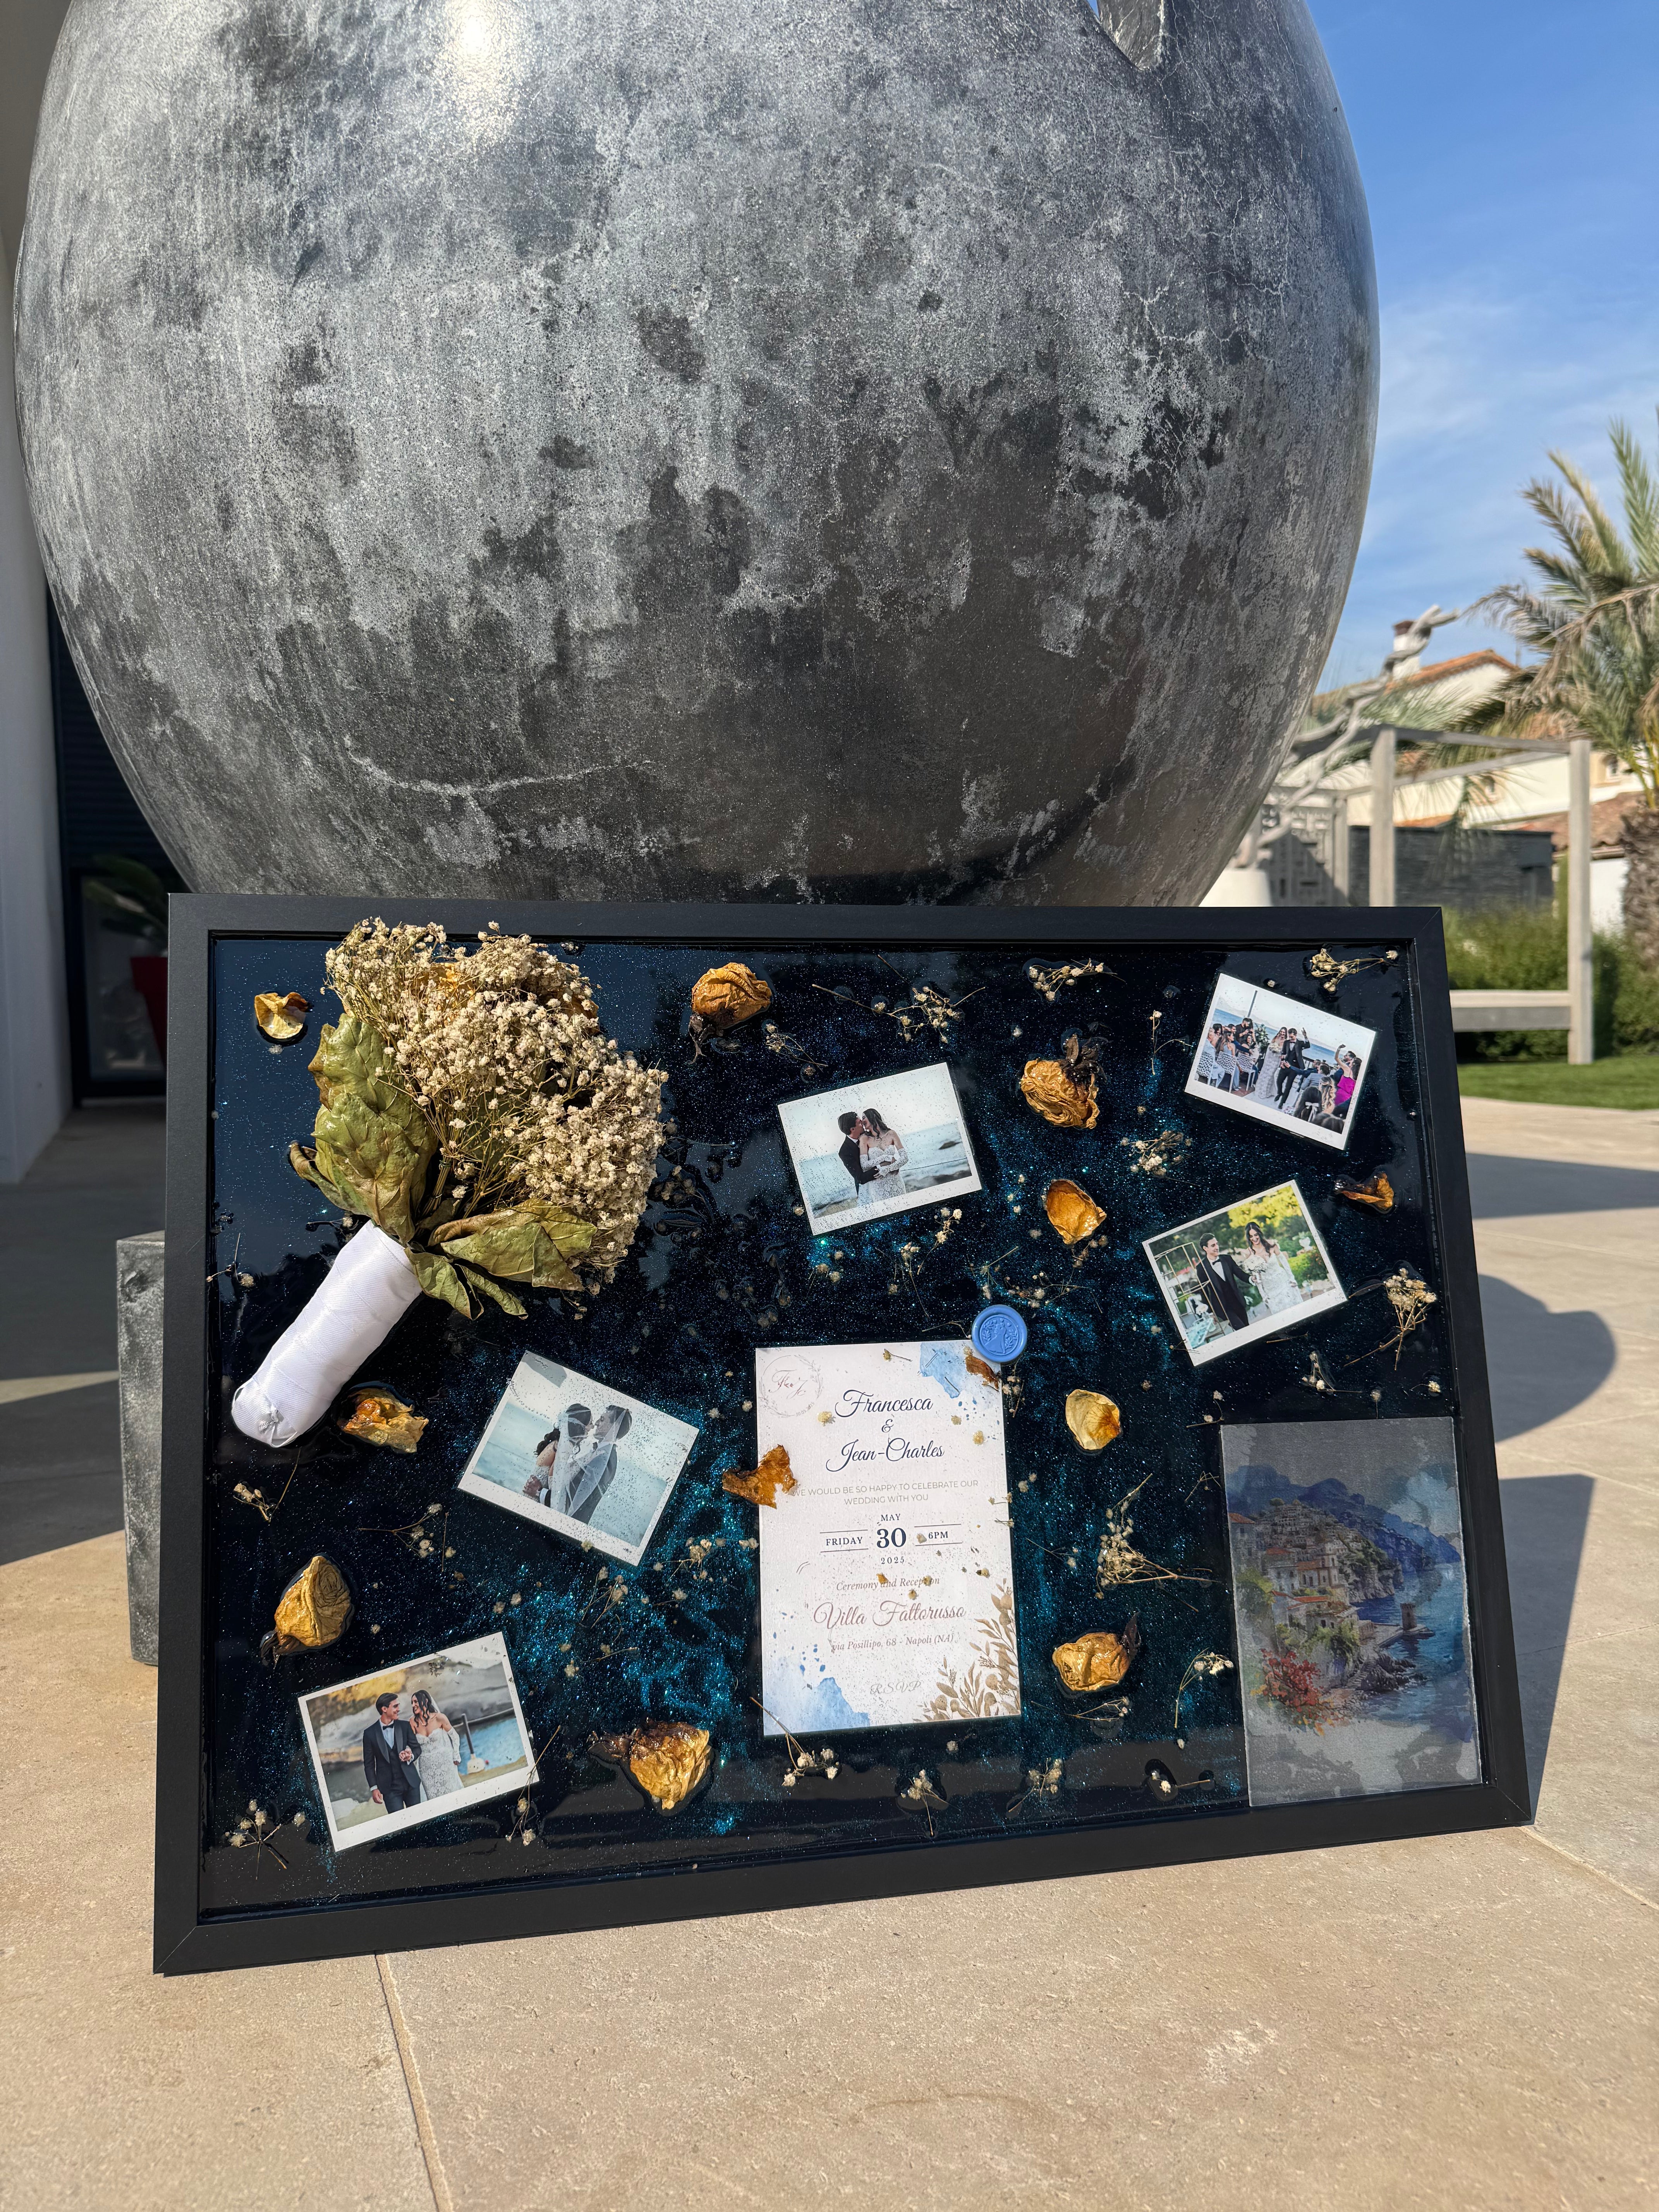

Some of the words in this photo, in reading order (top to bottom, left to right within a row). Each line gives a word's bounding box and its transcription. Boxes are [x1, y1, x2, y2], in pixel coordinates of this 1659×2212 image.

[835, 1389, 933, 1417] Francesca
[881, 1419, 894, 1432] &
[826, 1437, 945, 1472] Jean-Charles
[792, 1488, 806, 1496] WE
[808, 1487, 840, 1495] WOULD
[912, 1481, 958, 1489] CELEBRATE
[844, 1496, 885, 1505] WEDDING
[881, 1513, 901, 1522] MAY
[826, 1537, 863, 1546] FRIDAY
[876, 1527, 906, 1548] 30
[928, 1531, 948, 1539] 6PM
[836, 1582, 878, 1591] Ceremony
[881, 1578, 897, 1587] and
[900, 1578, 939, 1588] Recepon
[813, 1602, 867, 1629] Villa
[872, 1601, 966, 1626] Fattorusso
[847, 1639, 883, 1649] Posillipo,
[886, 1638, 896, 1646] 68
[905, 1635, 932, 1646] Napoli
[934, 1633, 954, 1645] (NA)
